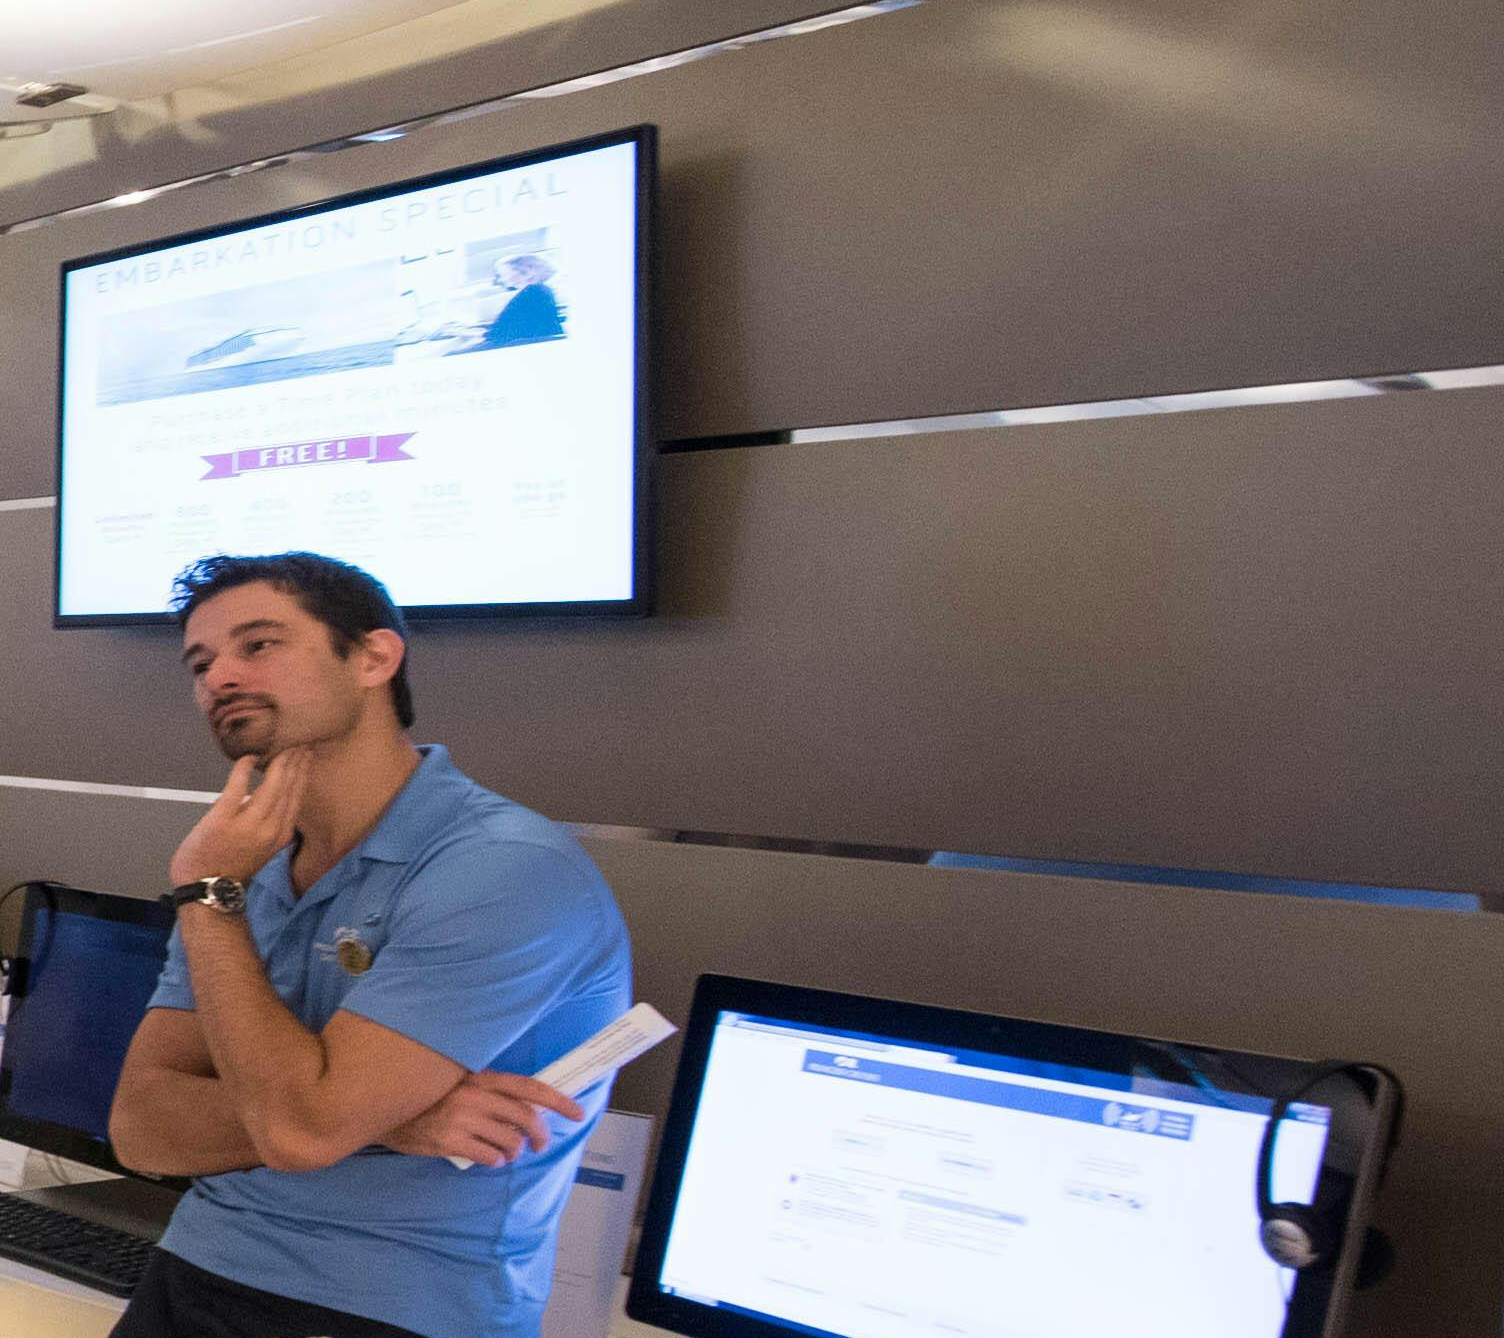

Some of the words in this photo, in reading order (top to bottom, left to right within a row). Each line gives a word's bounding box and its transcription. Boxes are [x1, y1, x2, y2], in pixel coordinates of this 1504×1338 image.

[94, 217, 356, 294] EMBARKATION
[378, 172, 569, 233] SPECIAL
[259, 440, 347, 467] FREE!
